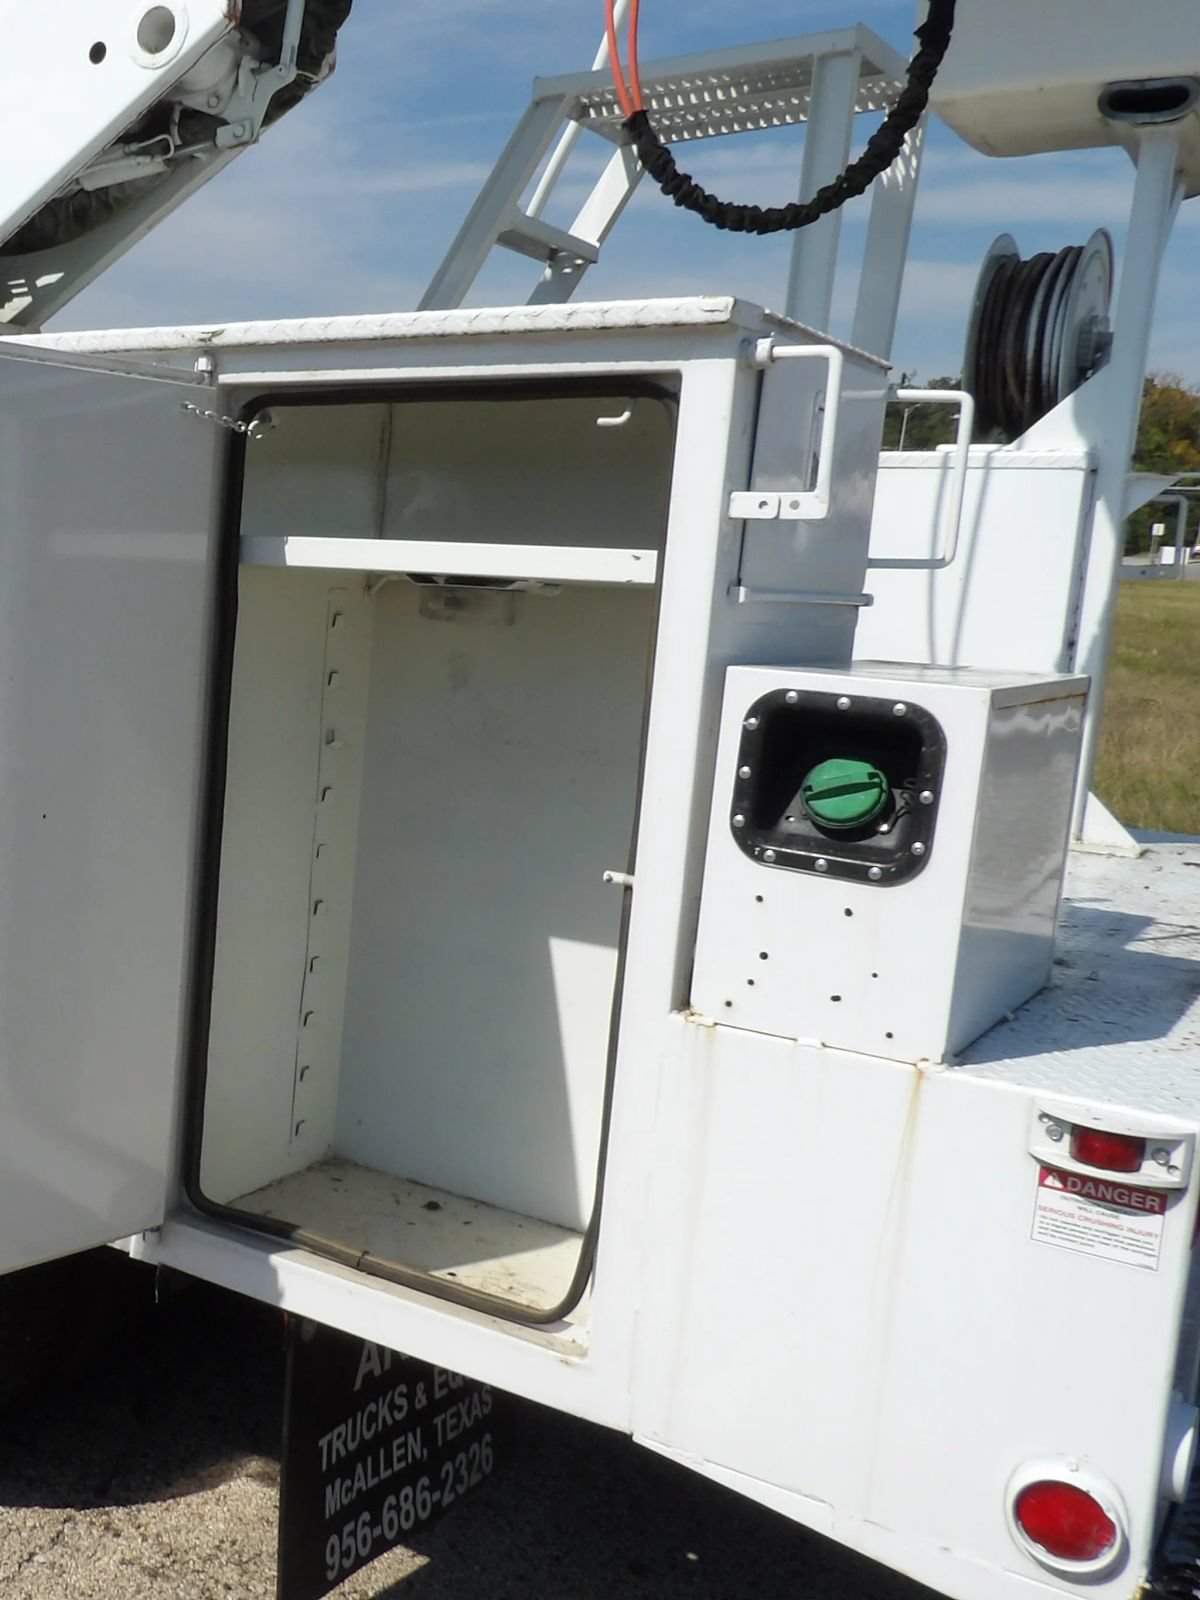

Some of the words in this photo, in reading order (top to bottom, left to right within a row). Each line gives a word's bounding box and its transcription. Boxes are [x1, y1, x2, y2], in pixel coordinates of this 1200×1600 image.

[1038, 1204, 1076, 1219] SERIOUS
[1077, 1214, 1125, 1232] CRUSHING
[1126, 1225, 1160, 1239] INJURY
[1067, 1177, 1161, 1212] DANGER
[318, 1383, 409, 1473] TRUCKS
[415, 1381, 428, 1411] &
[325, 1427, 428, 1520] McALLEN,
[433, 1384, 493, 1447] TEXAS
[325, 1432, 494, 1581] 956-686-2326
